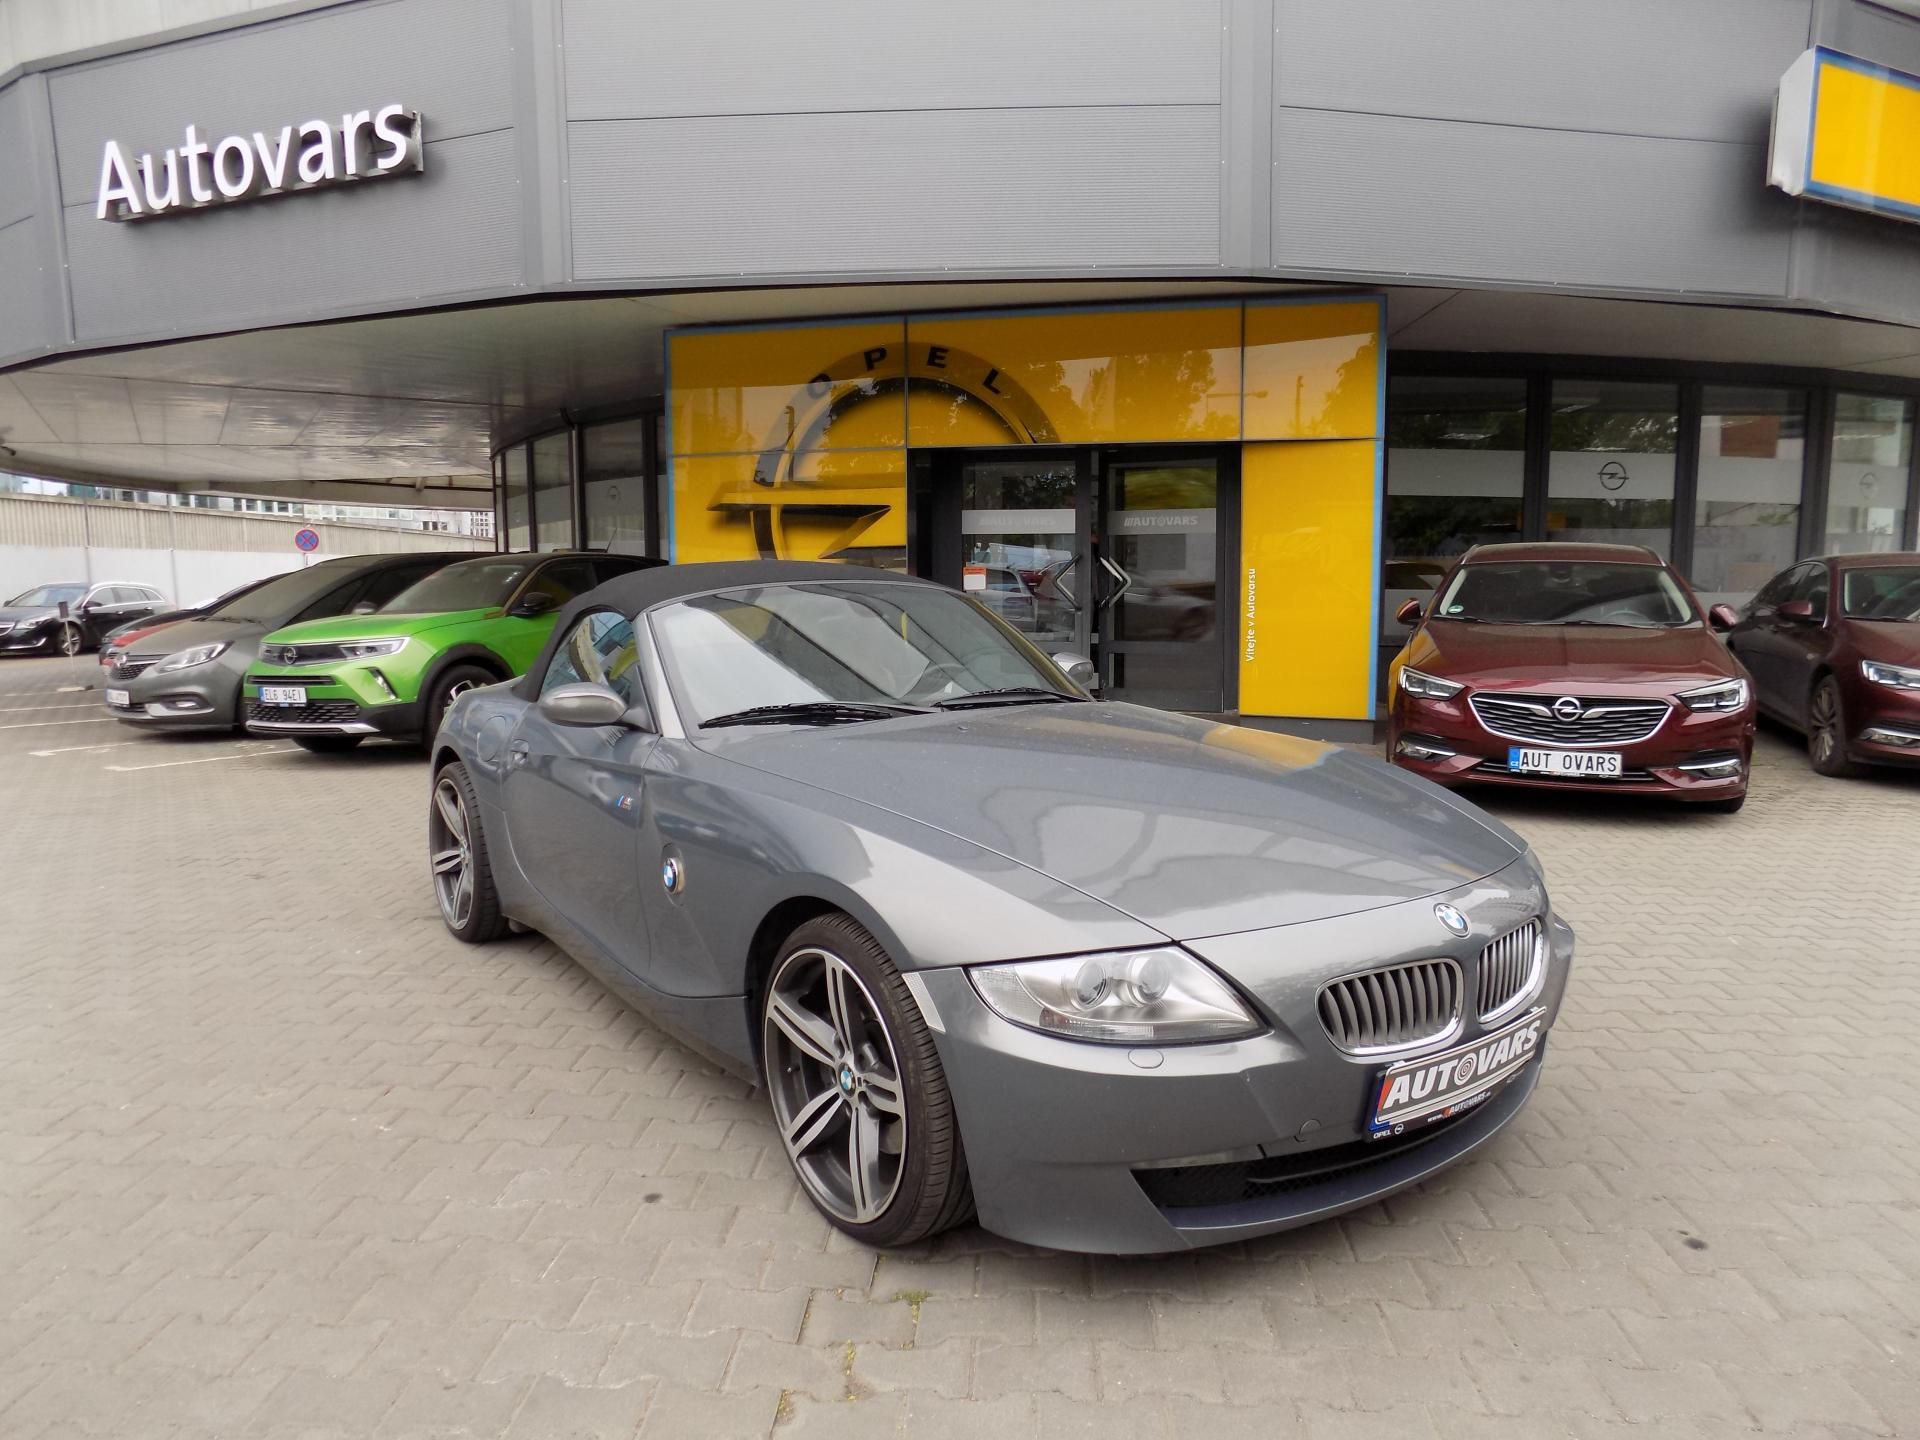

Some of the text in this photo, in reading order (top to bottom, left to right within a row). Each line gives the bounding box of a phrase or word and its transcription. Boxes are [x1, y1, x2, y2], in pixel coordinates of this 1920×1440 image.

[97, 104, 408, 219] Autovars
[807, 346, 1002, 399] OPEL
[1133, 515, 1199, 527] AUTOVARS
[1246, 568, 1256, 618] Autovarsu
[1521, 751, 1551, 769] AUT
[1562, 754, 1617, 772] OVARS
[1383, 1020, 1541, 1109] AUTOVARS
[1373, 1129, 1391, 1139] OPEL
